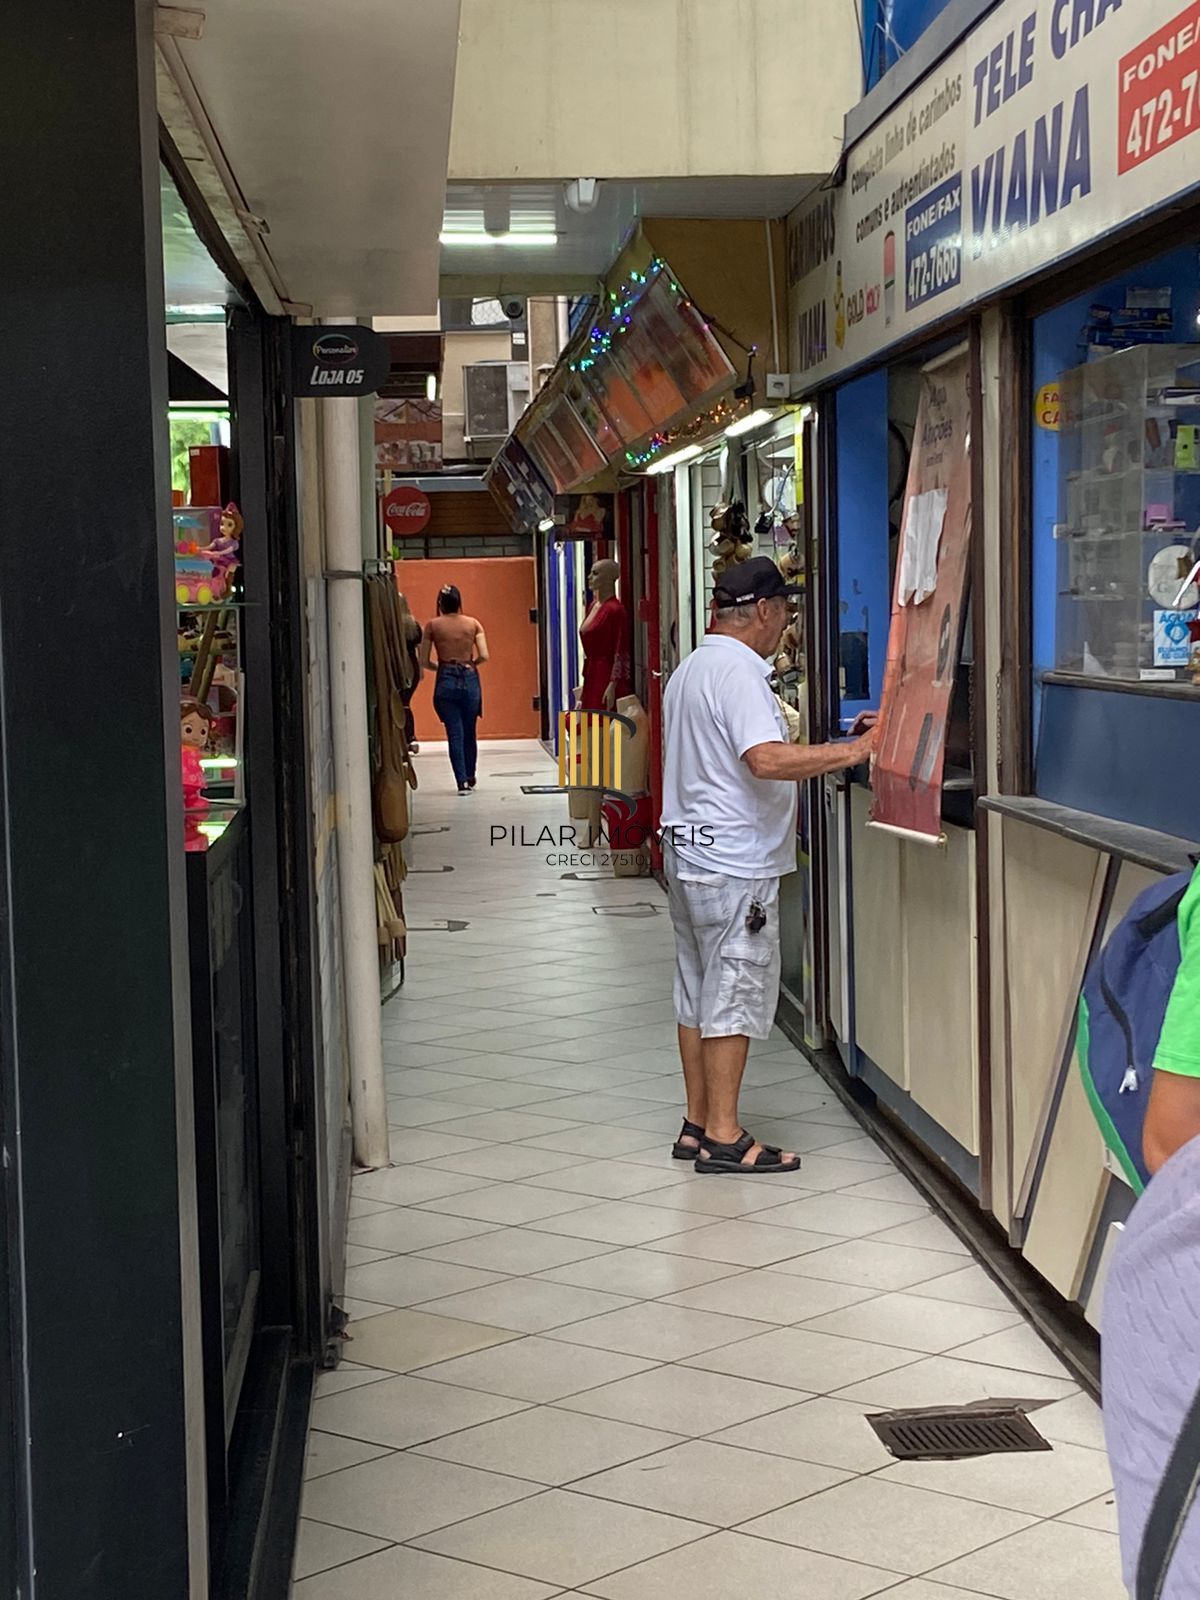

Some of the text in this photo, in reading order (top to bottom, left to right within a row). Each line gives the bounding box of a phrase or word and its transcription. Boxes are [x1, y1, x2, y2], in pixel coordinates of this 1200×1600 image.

[973, 11, 1036, 128] TELE
[852, 74, 962, 195] completa linha de carimbos
[1126, 70, 1200, 159] 472-7
[971, 83, 1091, 261] VIANA
[884, 198, 890, 222] e
[907, 186, 961, 241] FONE/FAX
[908, 244, 958, 302] 472-7666
[799, 298, 828, 372] VIANA
[310, 365, 364, 385] LOJA 05
